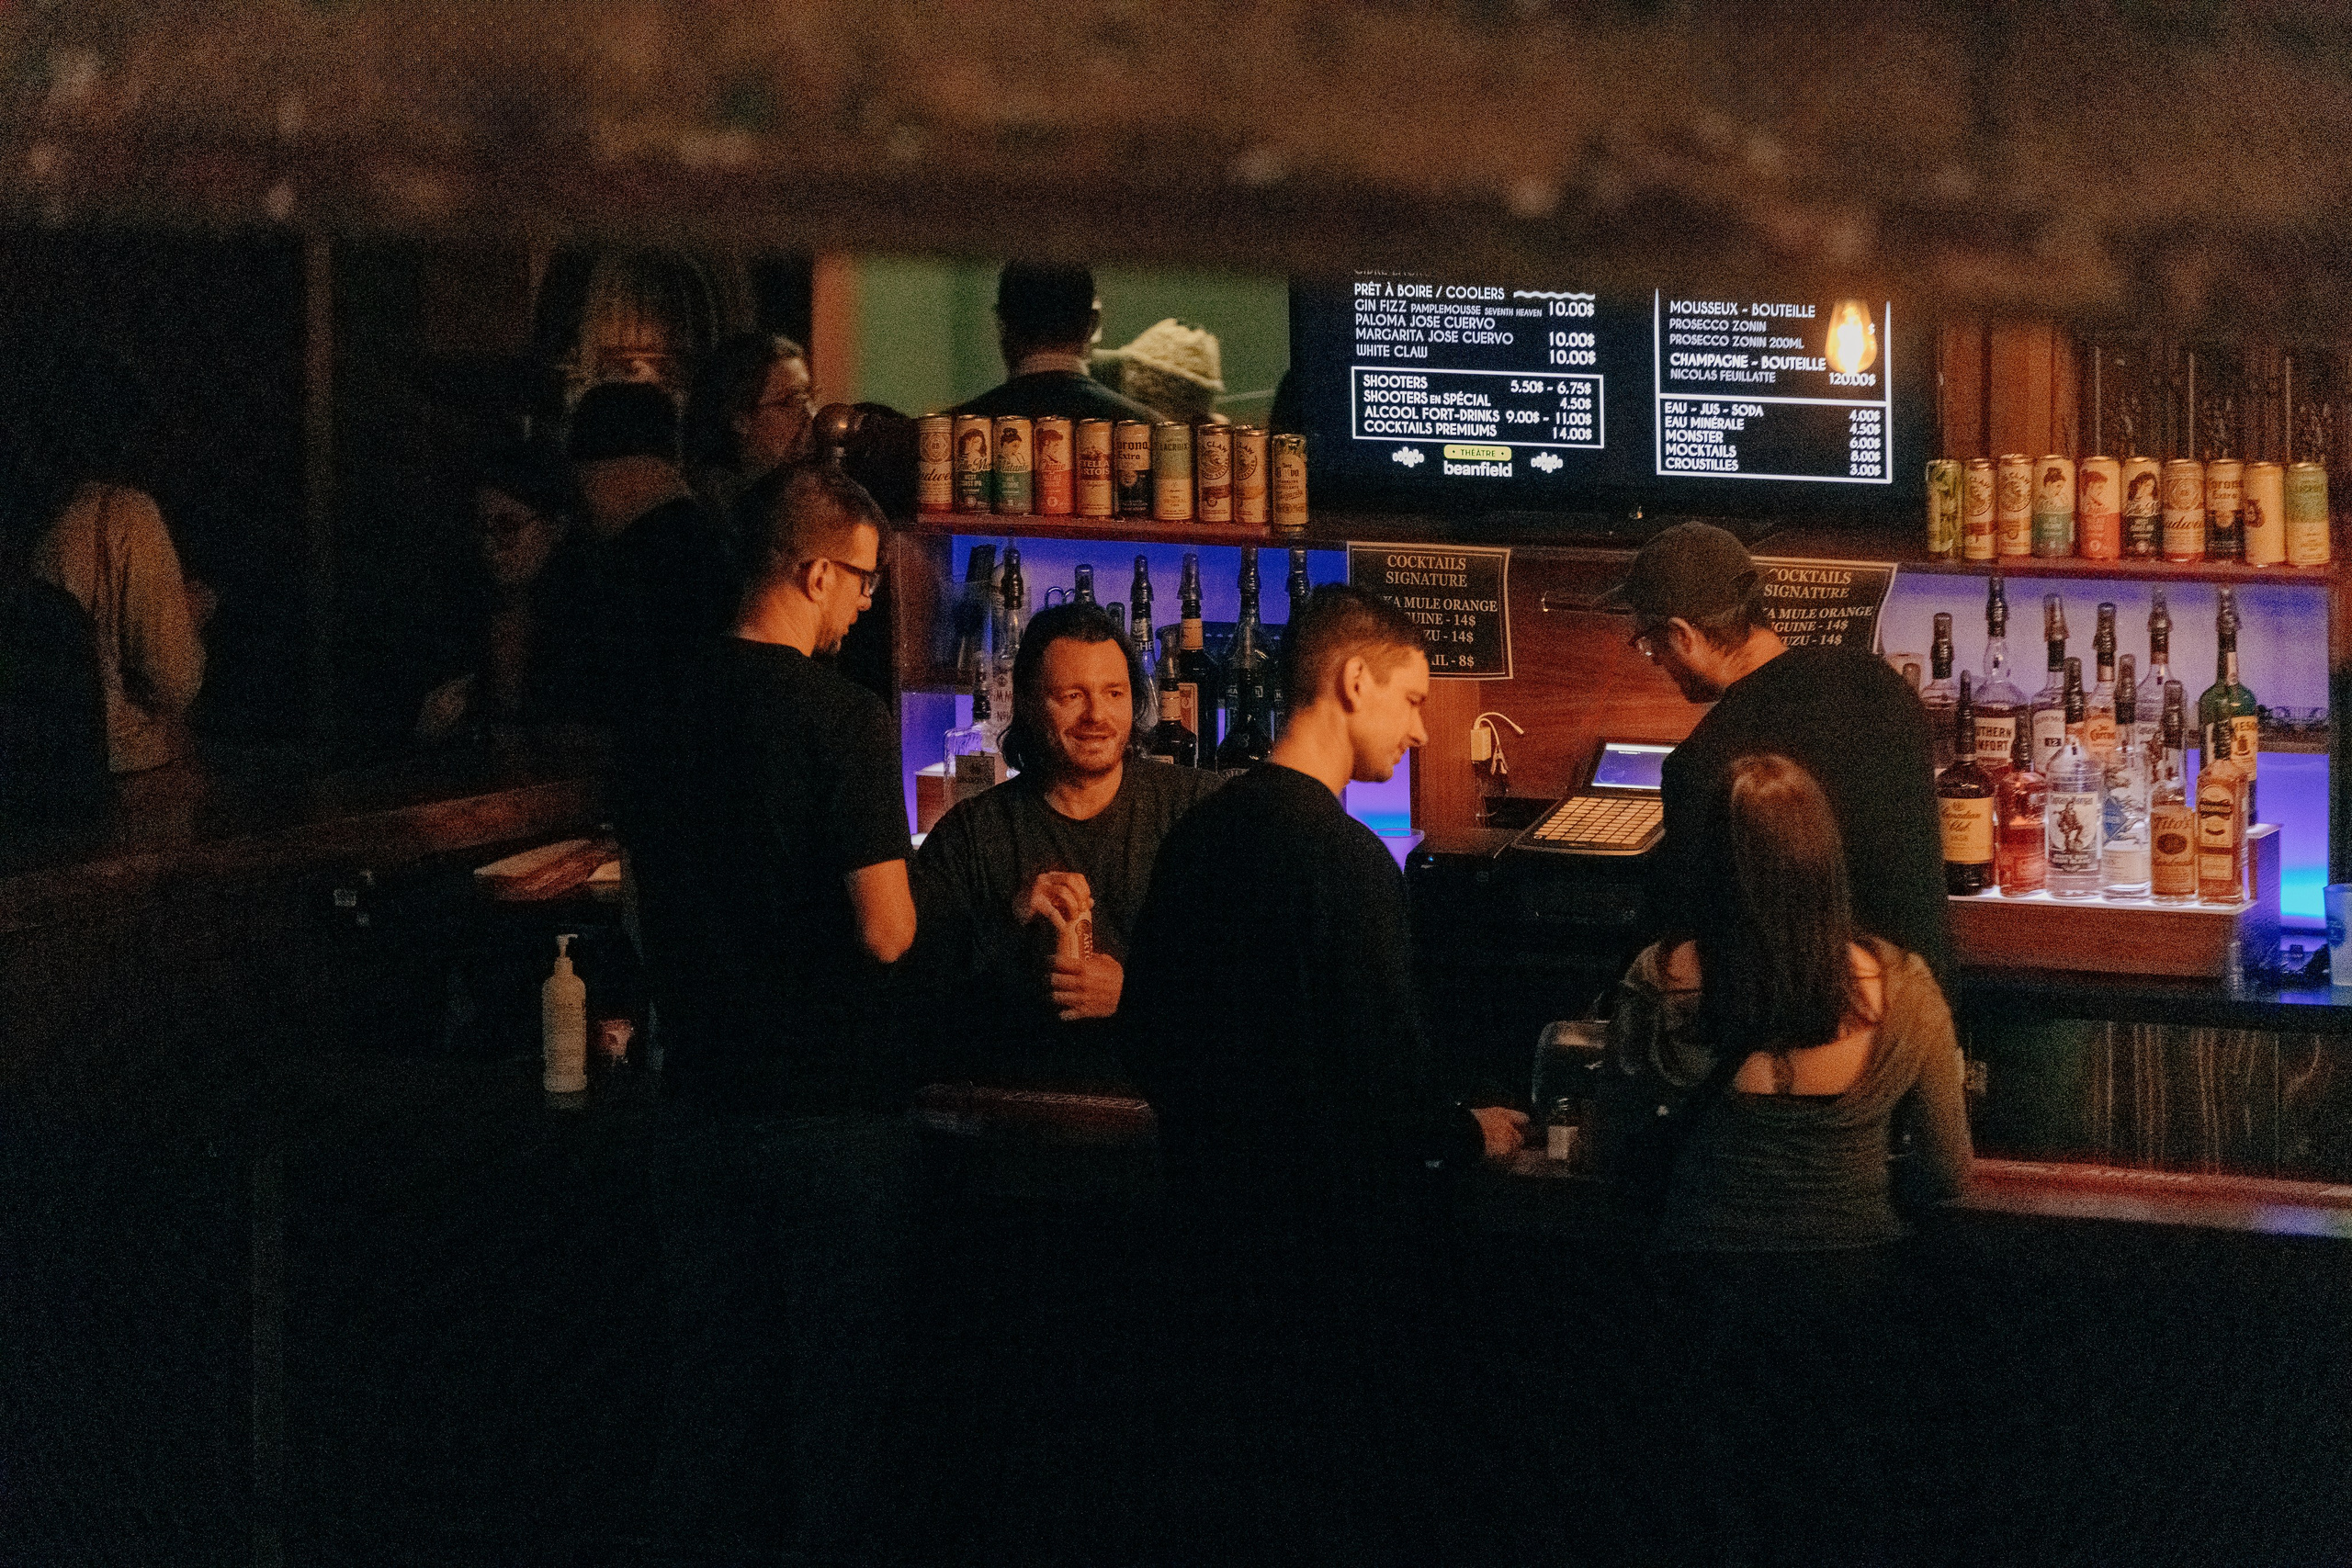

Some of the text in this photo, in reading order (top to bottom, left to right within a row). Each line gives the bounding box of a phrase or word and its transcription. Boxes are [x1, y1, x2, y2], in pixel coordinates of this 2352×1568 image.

[1354, 281, 1505, 300] PRÊT À BOIRE / COOLERS
[1354, 299, 1595, 318] GIN FIZZ PAMPLEMOUSSE SEVENTH HEAVEN 10.00$
[1669, 300, 1738, 315] MOUSSEUX
[1751, 302, 1815, 318] BOUTEILLE
[1355, 313, 1496, 330] PALOMA JOSE CUERVO
[1669, 318, 1767, 333] PROSECCO ZONIN
[1355, 327, 1596, 348] MARGARITA JOSE CUERVO 10.00$
[1669, 333, 1804, 350] PROSECCO ZONIN 200ML
[1356, 344, 1596, 366] WHITE CLAW 10.00$
[1670, 352, 1748, 368] CHAMPAGNE
[1761, 355, 1826, 371] BOUTEILLE
[1670, 368, 1717, 381] NICOLAS
[1719, 369, 1776, 383] FEUILLATTE
[1363, 374, 1428, 389] SHOOTERS
[1510, 379, 1544, 394] 5.50$
[1556, 381, 1592, 395] 6.75$
[1363, 389, 1592, 411] SHOOTERS EN SPÉCIAL 4.50$
[1364, 405, 1419, 420] ALCOOL
[1421, 407, 1500, 423] FORT-DRINKS
[1505, 410, 1540, 424] 9.00$
[1555, 412, 1592, 426] 11.00$
[1665, 401, 1687, 414] EAU
[1700, 403, 1720, 415] JUS
[1731, 404, 1764, 417] SODA
[1849, 409, 1881, 423] 4.00$
[1363, 420, 1592, 441] COCKTAILS PREMIUMS 14.00$
[1665, 415, 1881, 436] EAU MINÉRALE 4.50$
[1665, 429, 1881, 450] MONSTER 6.00$
[1665, 443, 1736, 458] MOCKTAILS
[1443, 460, 1513, 478] beanfield
[1665, 457, 1882, 477] CROUSTILLES 3.00$
[1387, 555, 1466, 570] COCKTAILS
[1385, 571, 1467, 588] SIGNATURE
[1763, 584, 1849, 599] SIGNATURE
[1404, 596, 1441, 610] MULE
[1442, 598, 1498, 613] ORANGE
[1779, 608, 1817, 620] MULE
[1818, 606, 1874, 618] ORANGE
[1453, 614, 1476, 627] 14$
[1826, 619, 1849, 632] 14$
[1452, 630, 1474, 644] 14$
[1821, 634, 1843, 647] 14$
[1459, 654, 1475, 667] 8$
